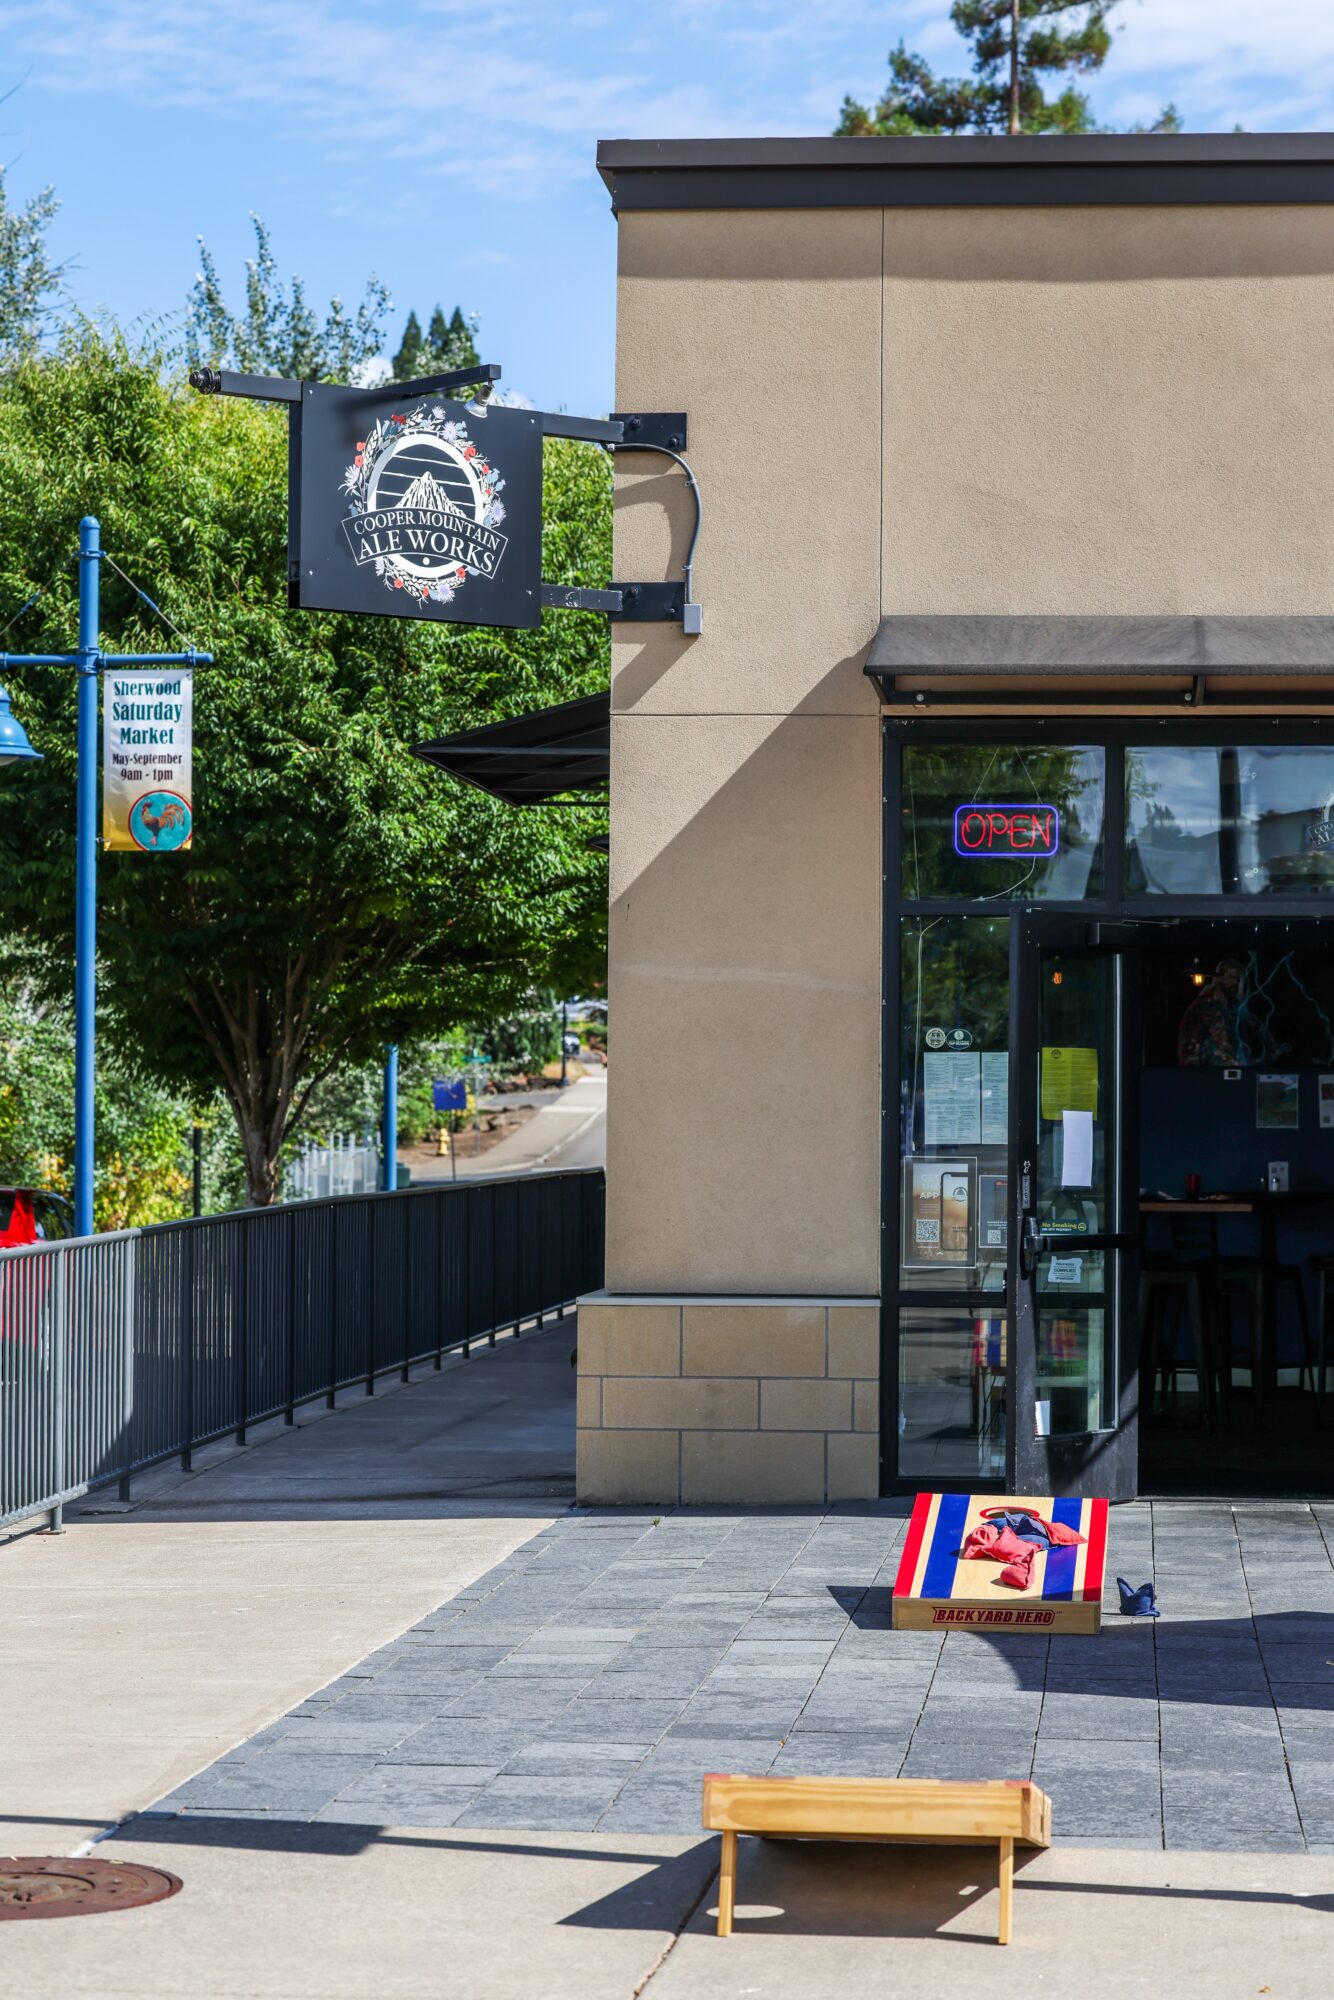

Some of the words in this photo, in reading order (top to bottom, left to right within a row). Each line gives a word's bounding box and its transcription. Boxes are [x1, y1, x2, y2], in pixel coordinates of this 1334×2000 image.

[354, 510, 416, 535] COOPER
[418, 510, 500, 550] MOUNTAIN
[359, 529, 403, 560] ALE
[405, 529, 495, 573] WORKS
[114, 680, 181, 696] Sherwood
[112, 701, 183, 723] Saturday
[120, 727, 174, 744] Market
[112, 753, 183, 766] May-September
[120, 768, 142, 781] 9am
[153, 768, 173, 782] 1pm
[961, 813, 1052, 848] OPEN
[936, 1609, 1013, 1622] BACKYARD
[1015, 1611, 1053, 1624] HERO
